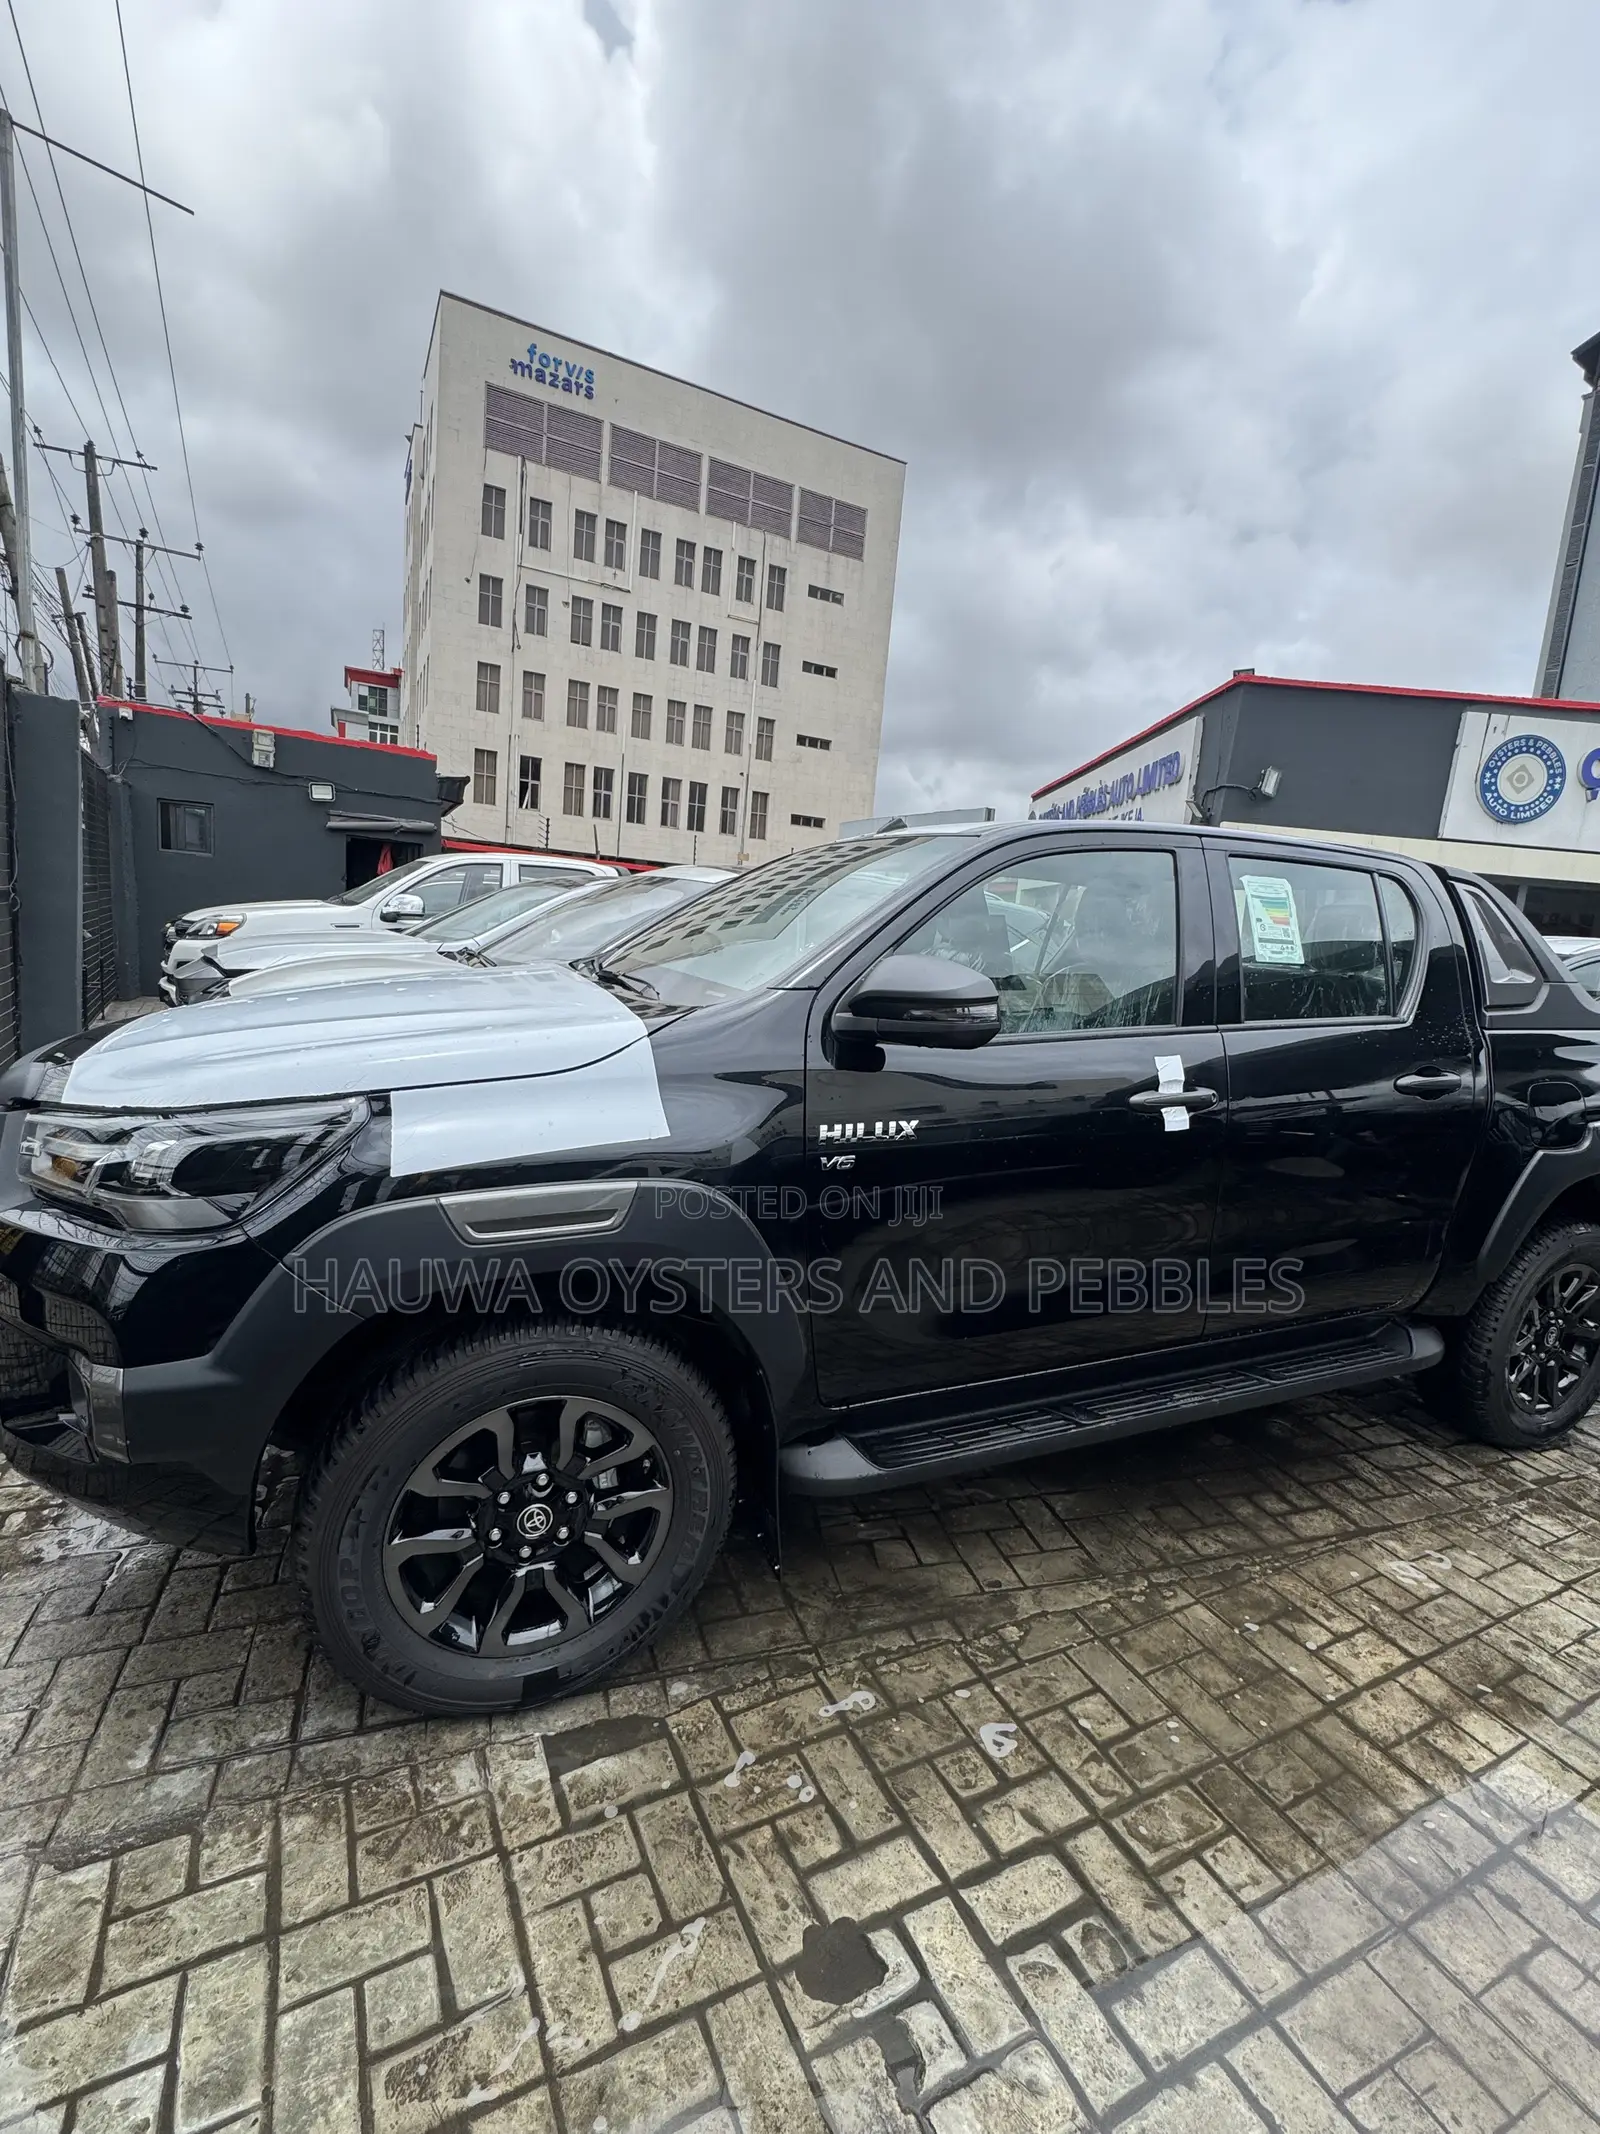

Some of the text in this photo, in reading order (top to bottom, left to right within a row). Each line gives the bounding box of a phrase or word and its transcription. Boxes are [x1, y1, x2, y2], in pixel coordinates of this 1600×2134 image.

[510, 358, 594, 399] mazars
[527, 343, 594, 384] forvis
[1136, 751, 1180, 793] LIMITED
[1488, 738, 1527, 768] OYSTERS
[1528, 738, 1535, 746] &
[1535, 740, 1563, 775] PEBBLES
[1485, 792, 1555, 820] AUTO LIMITED
[818, 1119, 920, 1146] HILUX
[820, 1155, 856, 1171] V6
